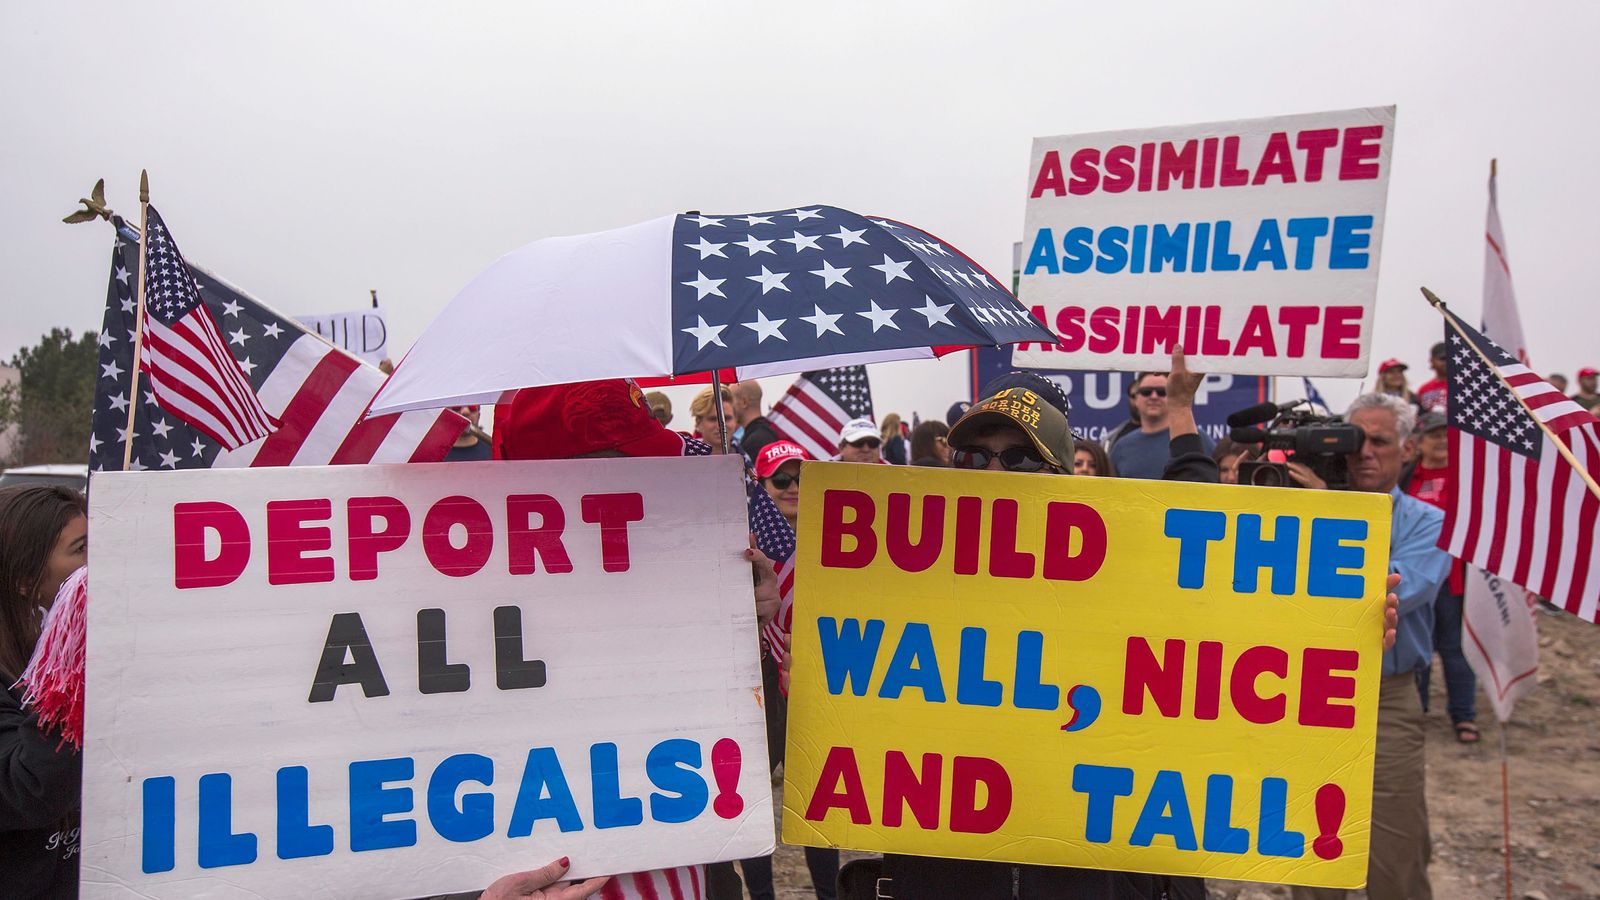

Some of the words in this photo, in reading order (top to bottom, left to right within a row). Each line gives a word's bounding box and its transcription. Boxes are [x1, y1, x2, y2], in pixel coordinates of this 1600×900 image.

[1030, 125, 1384, 199] ASSIMILATE
[1023, 215, 1374, 275] ASSIMILATE
[1017, 305, 1364, 360] ASSIMILATE
[765, 444, 803, 459] TRUMP
[998, 406, 1039, 429] TROL
[173, 492, 645, 590] DEPORT
[821, 489, 1108, 582] BUILD
[1164, 508, 1368, 599] THE
[308, 605, 547, 703] ALL
[817, 616, 1102, 732] WALL,
[1122, 636, 1359, 729] NICE
[141, 737, 744, 874] ILLEGALS!
[804, 746, 1013, 834] AND
[1072, 763, 1346, 861] TALL!
